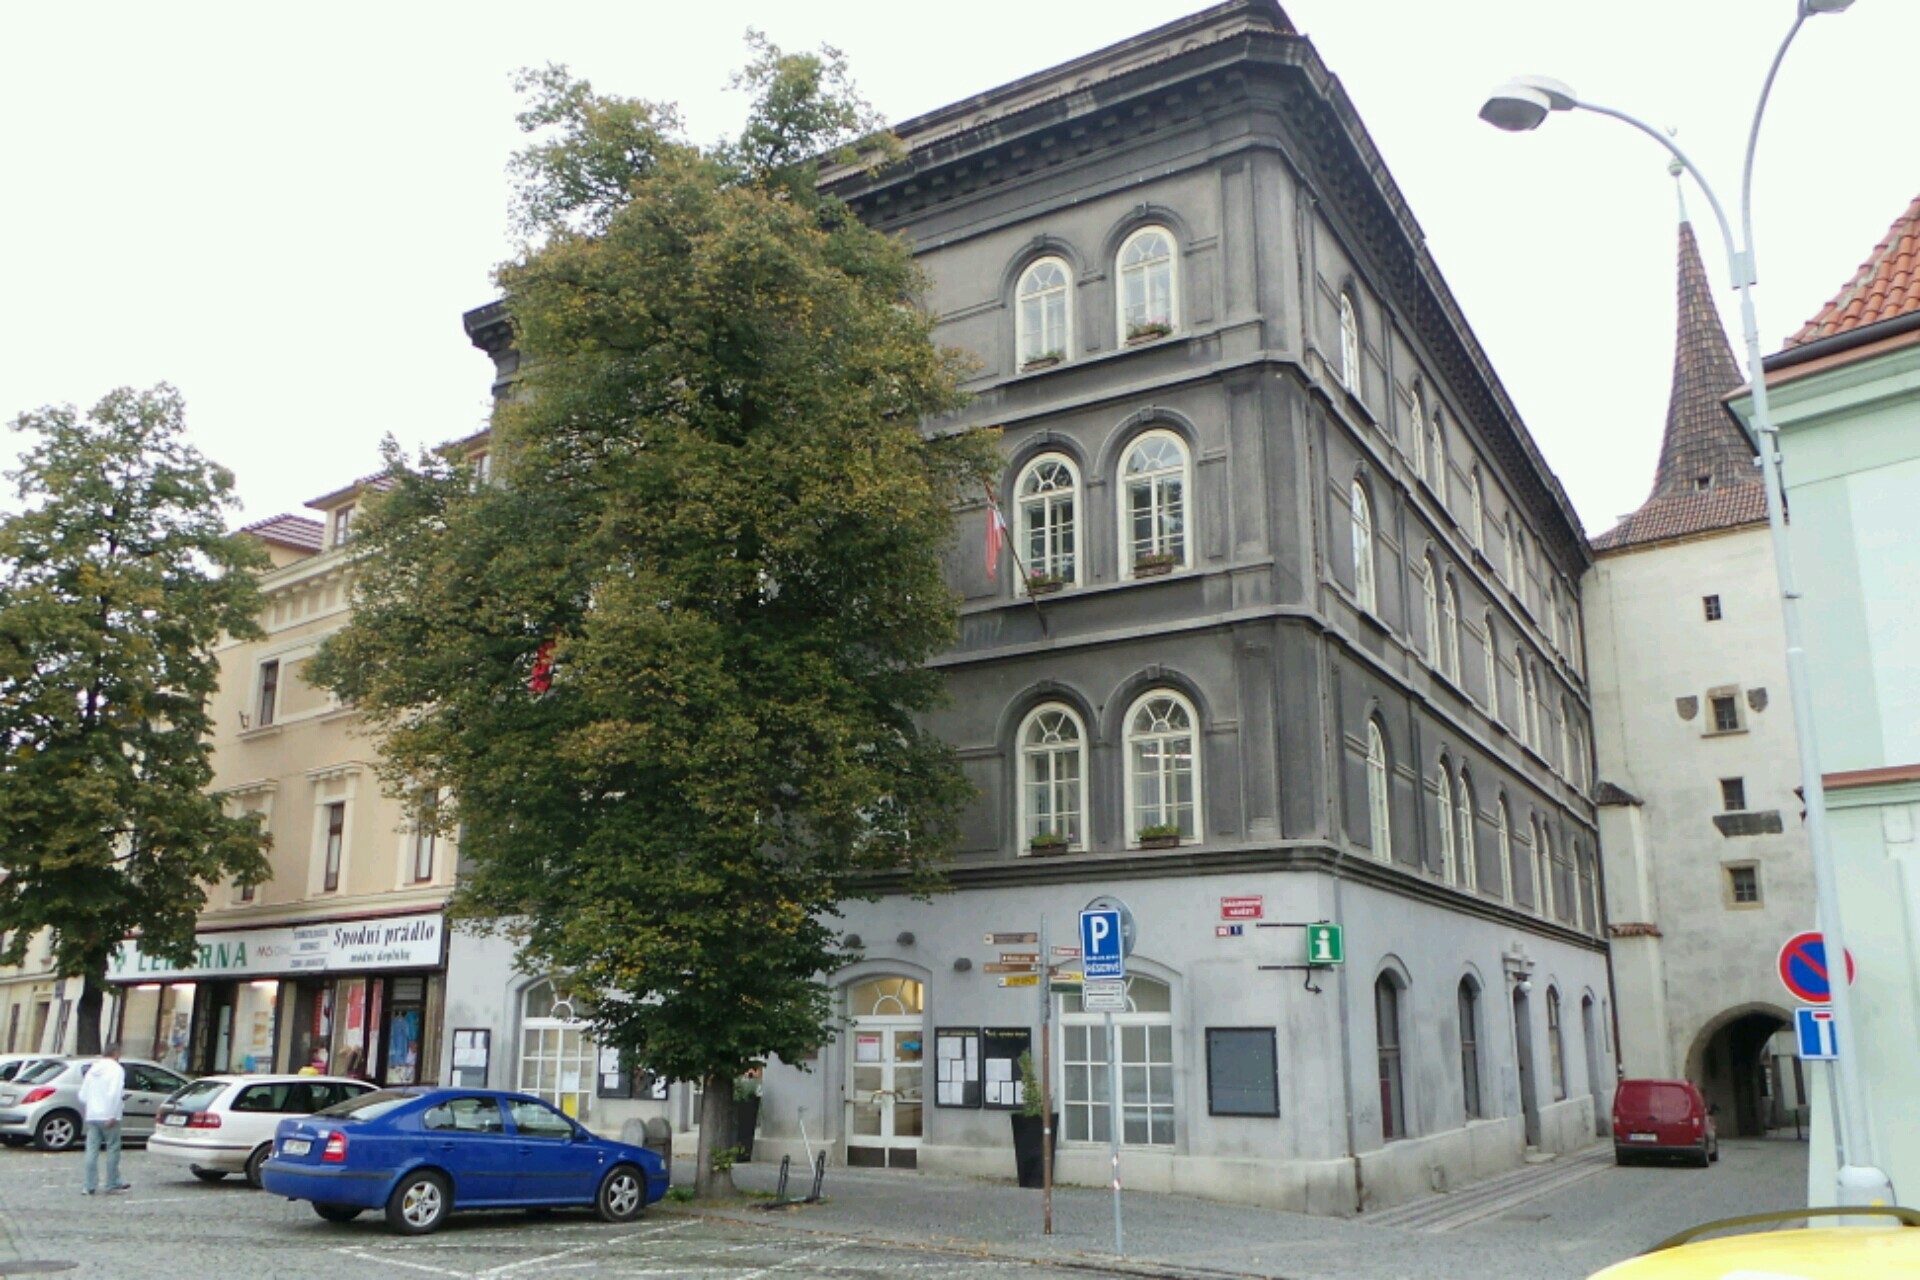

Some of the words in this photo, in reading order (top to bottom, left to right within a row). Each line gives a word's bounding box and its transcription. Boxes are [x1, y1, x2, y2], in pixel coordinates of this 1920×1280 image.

[333, 924, 381, 949] Spodní
[384, 920, 435, 946] prádlo
[1090, 915, 1109, 955] P
